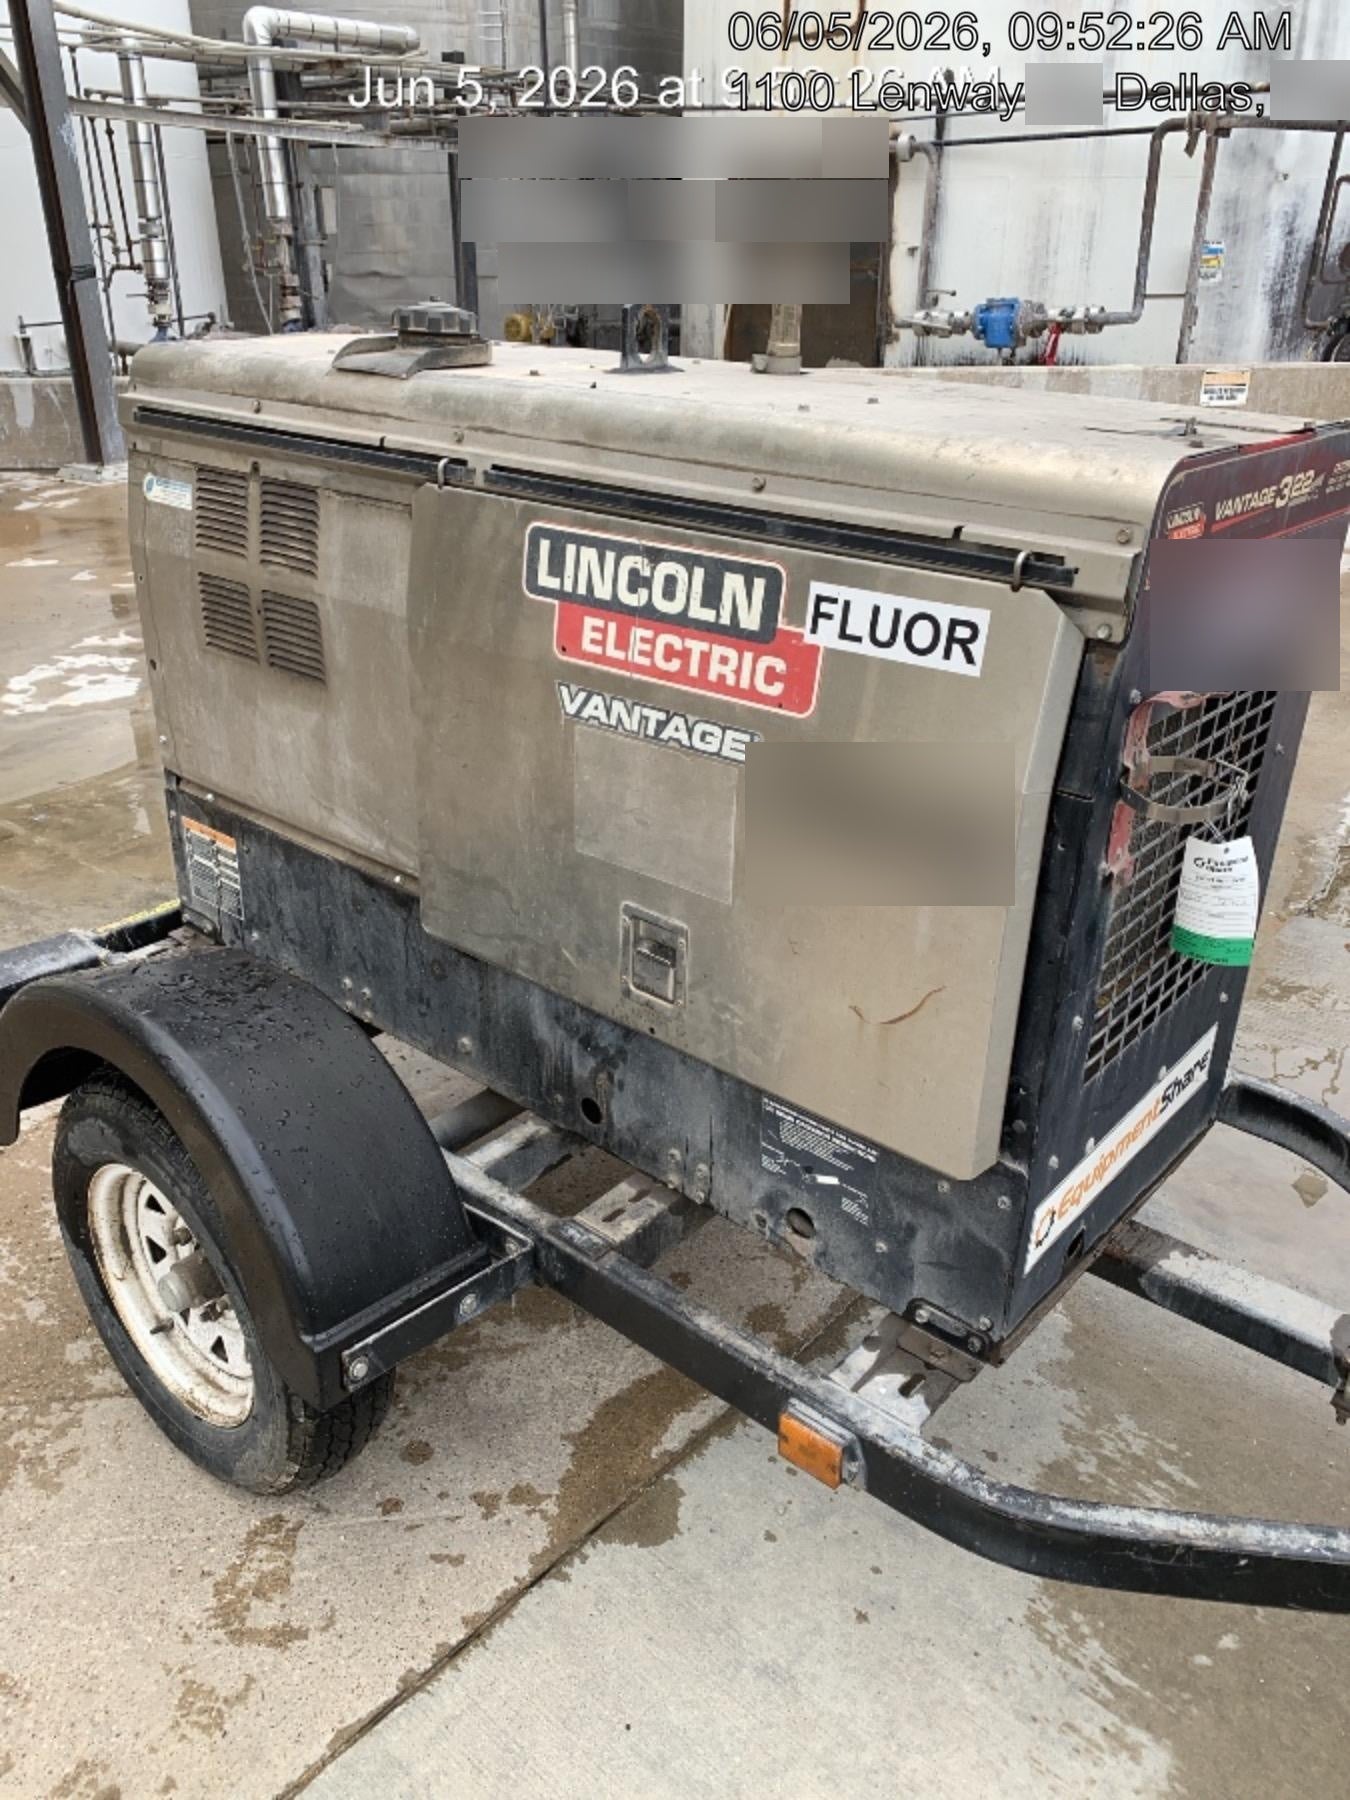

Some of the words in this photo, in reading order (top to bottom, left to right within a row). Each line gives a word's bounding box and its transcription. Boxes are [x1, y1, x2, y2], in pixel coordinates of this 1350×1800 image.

[1215, 485, 1277, 521] VANTAGE
[1275, 469, 1315, 509] 322
[537, 538, 766, 631] LINCOLN
[581, 615, 788, 697] ELECTRIC
[810, 594, 980, 667] FLUOR
[558, 682, 747, 762] VANTAGE
[1057, 1049, 1210, 1219] EquipmentShare
